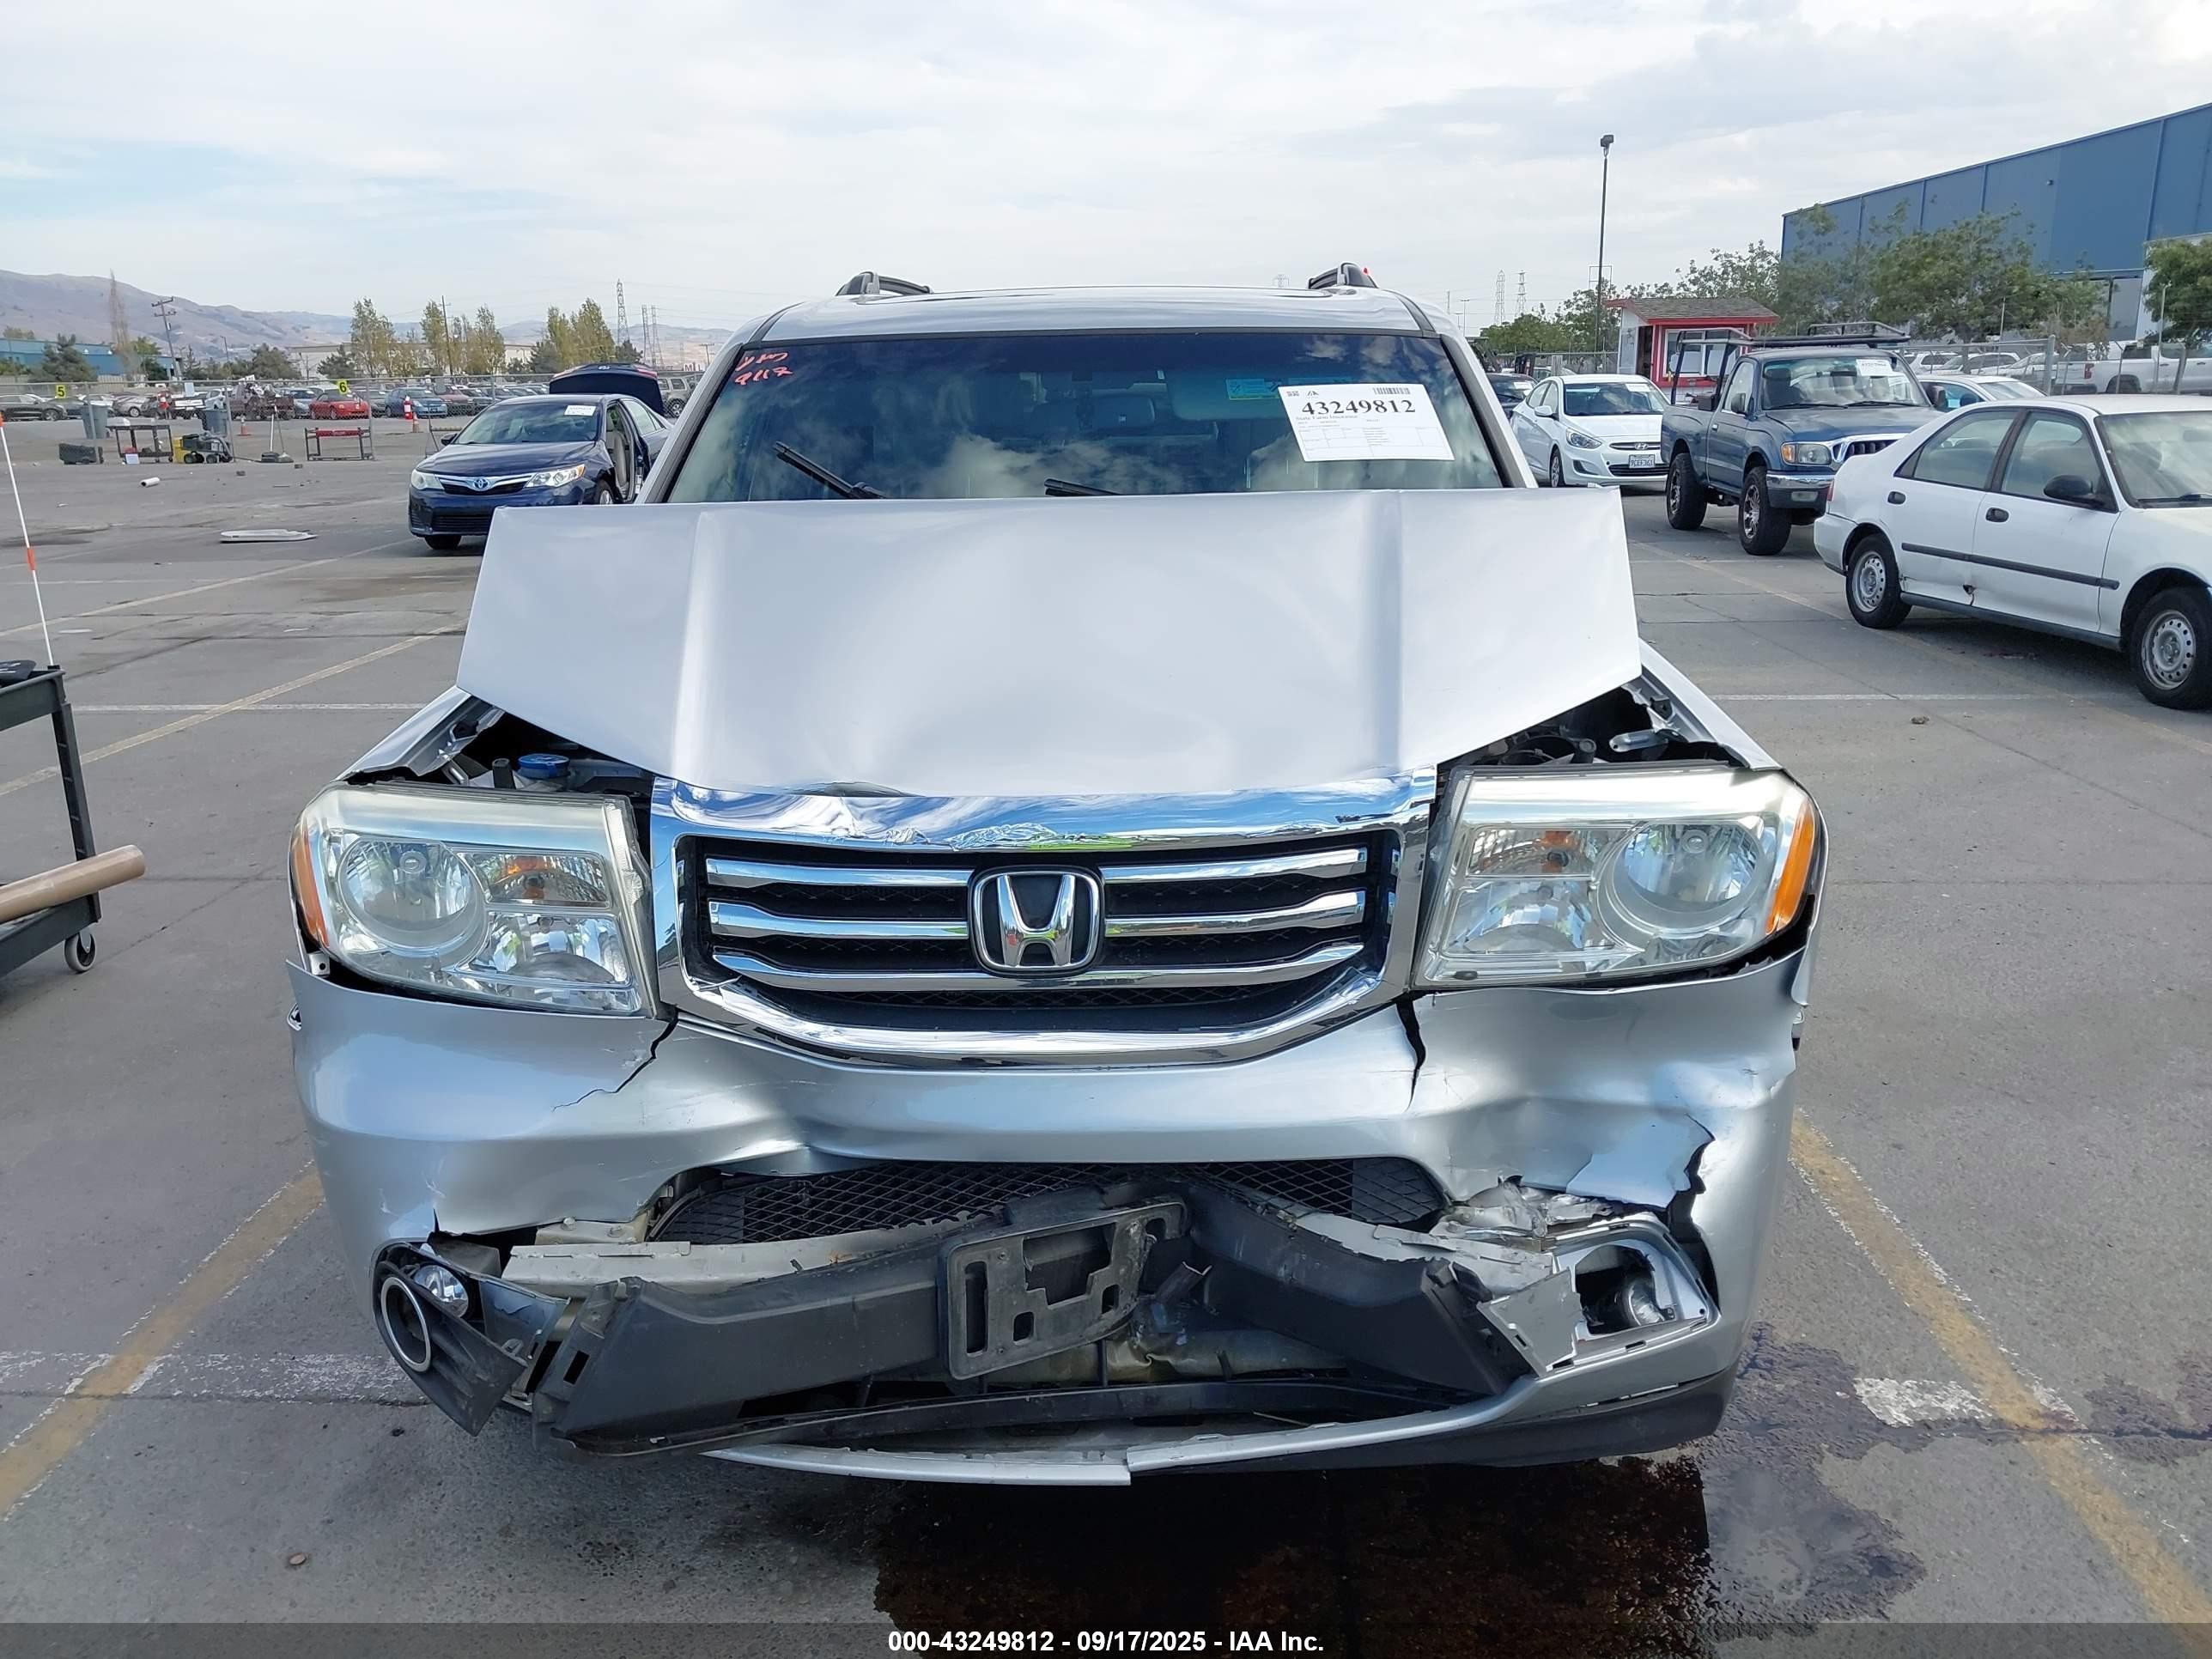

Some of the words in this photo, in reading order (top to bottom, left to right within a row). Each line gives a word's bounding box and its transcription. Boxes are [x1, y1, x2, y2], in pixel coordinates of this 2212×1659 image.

[58, 386, 65, 398] 5
[339, 381, 347, 392] 6
[1302, 399, 1416, 415] 43249812
